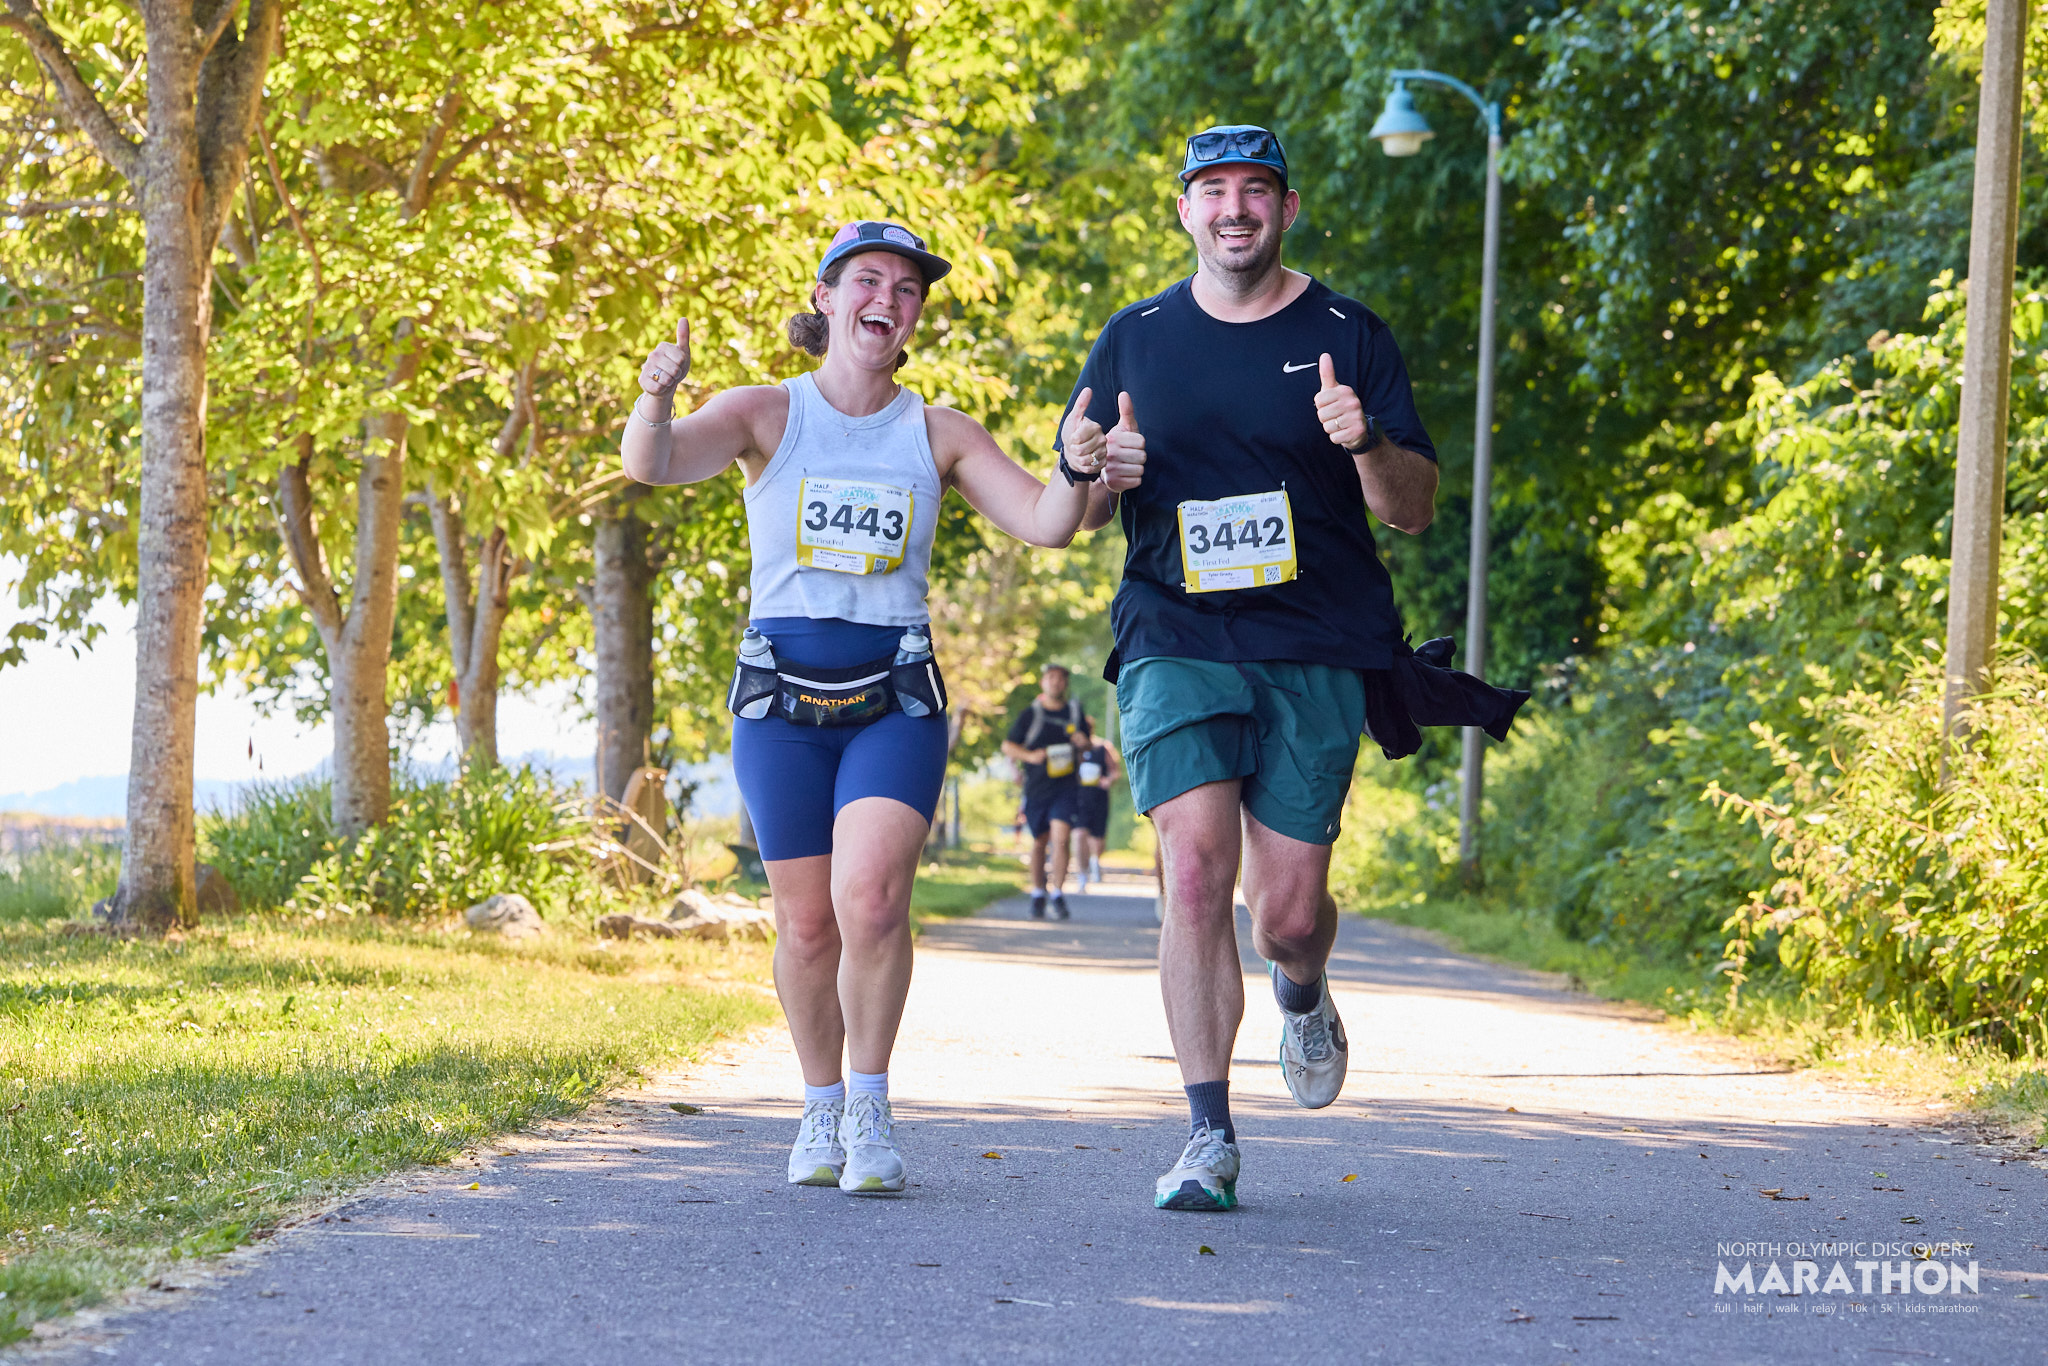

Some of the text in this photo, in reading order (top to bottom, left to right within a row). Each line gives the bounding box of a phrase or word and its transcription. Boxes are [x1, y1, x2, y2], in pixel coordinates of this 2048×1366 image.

[805, 500, 904, 541] 3443
[1189, 517, 1286, 554] 3442
[816, 537, 844, 547] First Fed
[1202, 557, 1230, 567] First Fed
[812, 694, 866, 706] NATHAN
